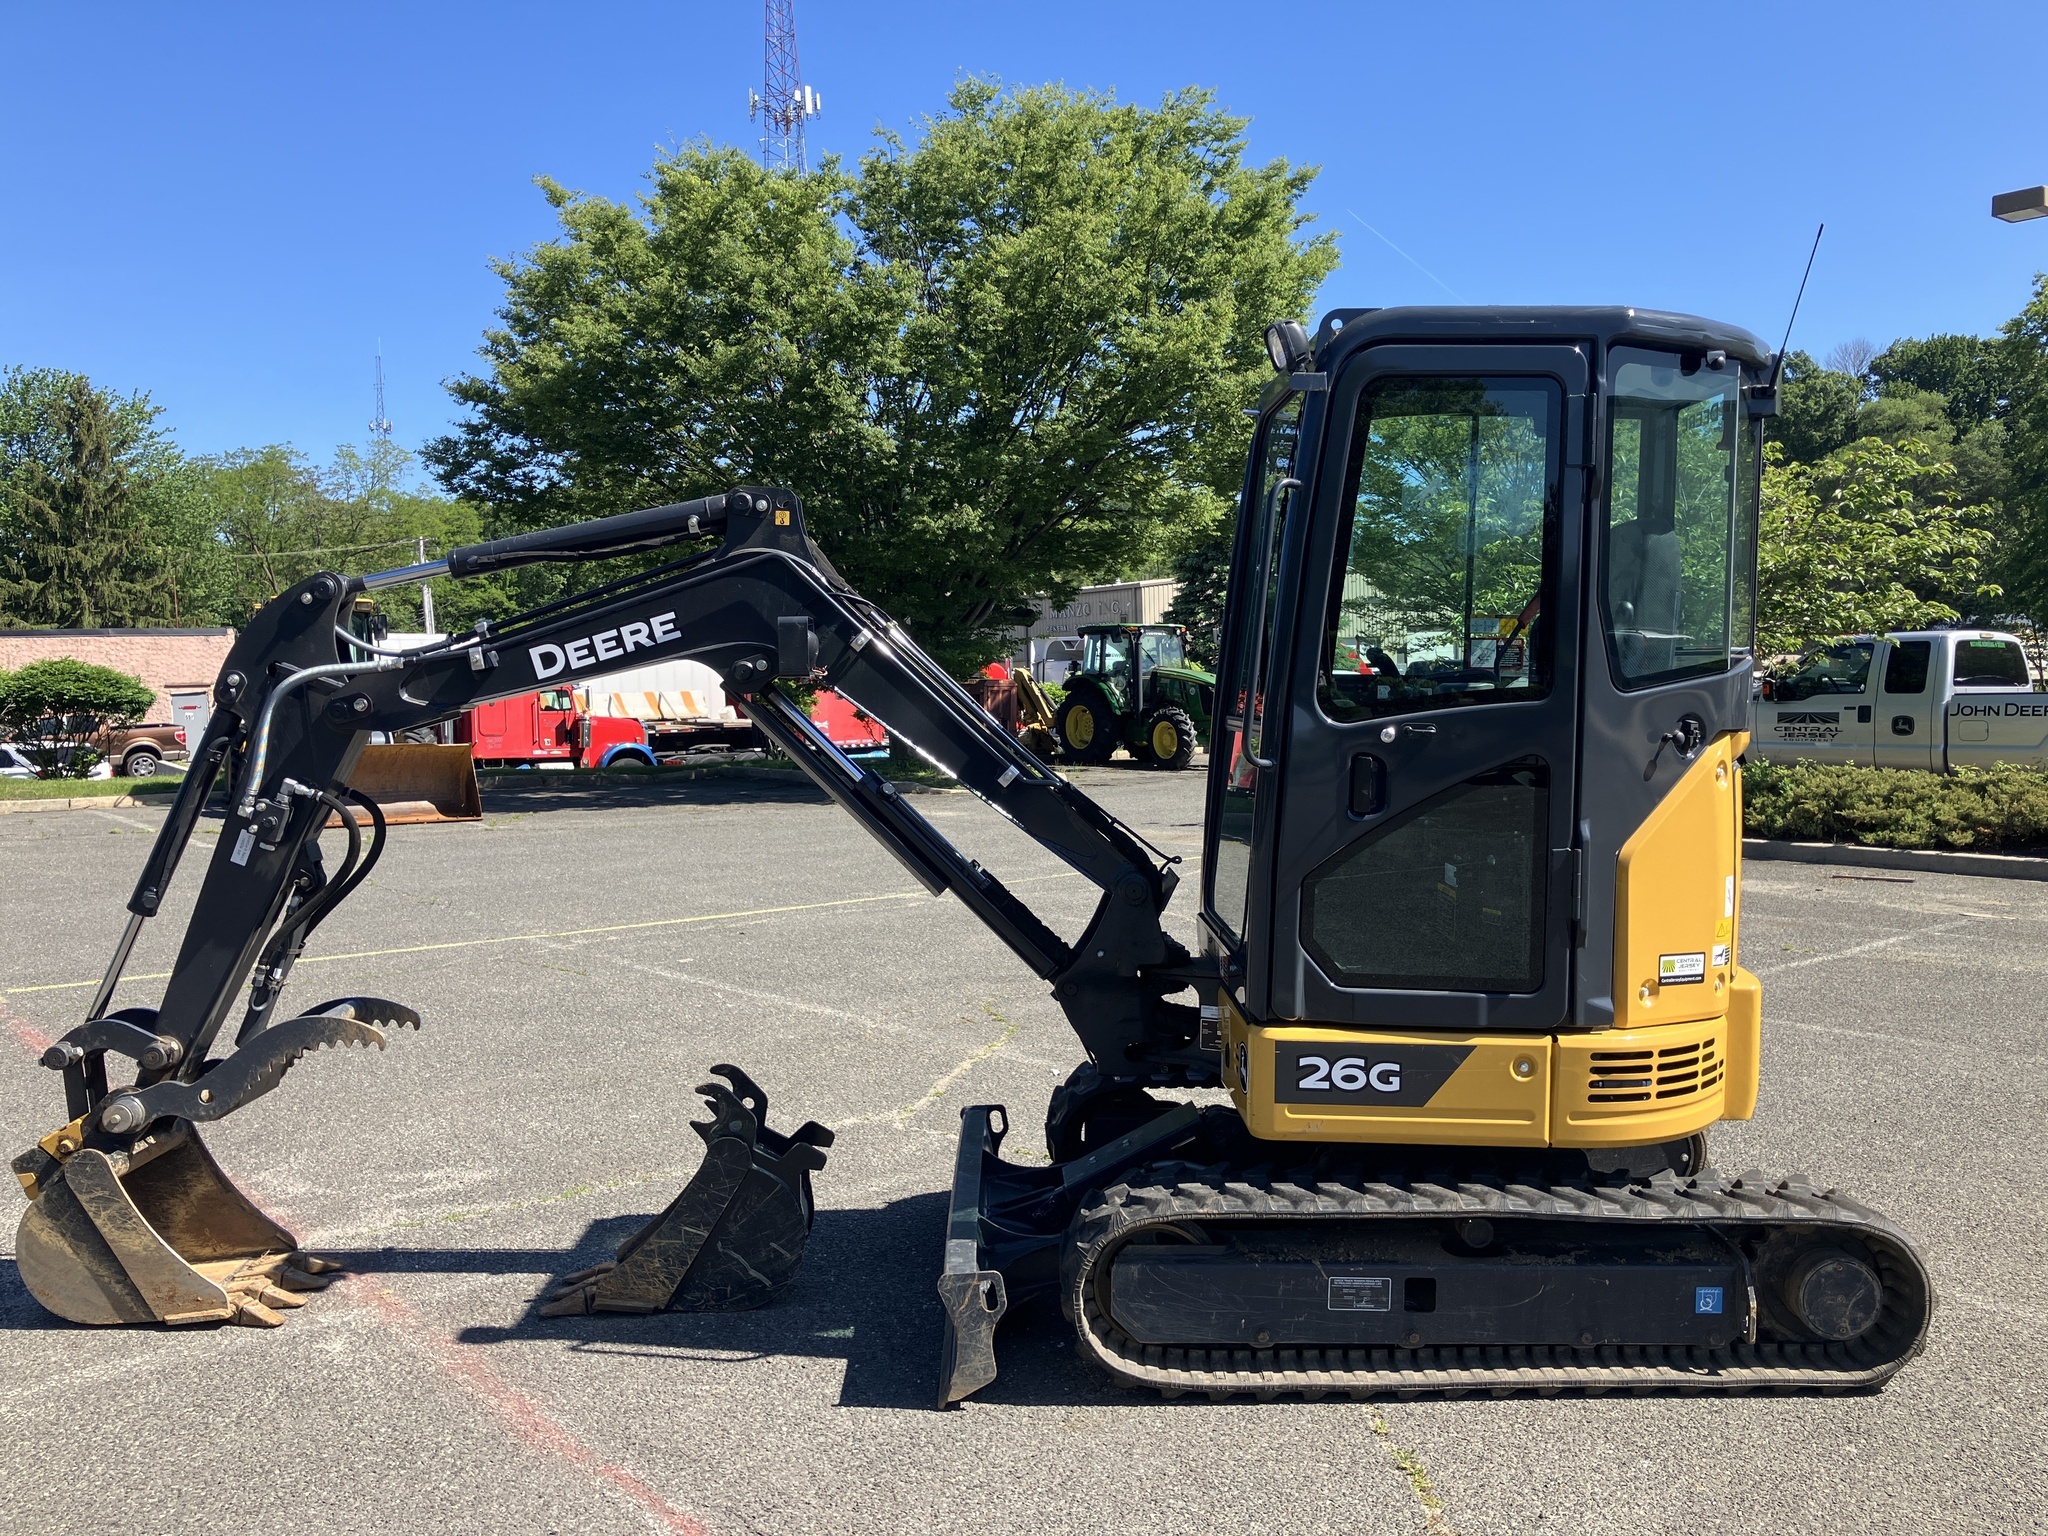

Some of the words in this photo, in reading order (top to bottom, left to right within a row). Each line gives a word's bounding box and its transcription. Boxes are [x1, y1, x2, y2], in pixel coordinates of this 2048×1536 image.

[529, 612, 682, 680] DEERE
[1950, 703, 2000, 716] JOHN
[1299, 1056, 1400, 1092] 26G
